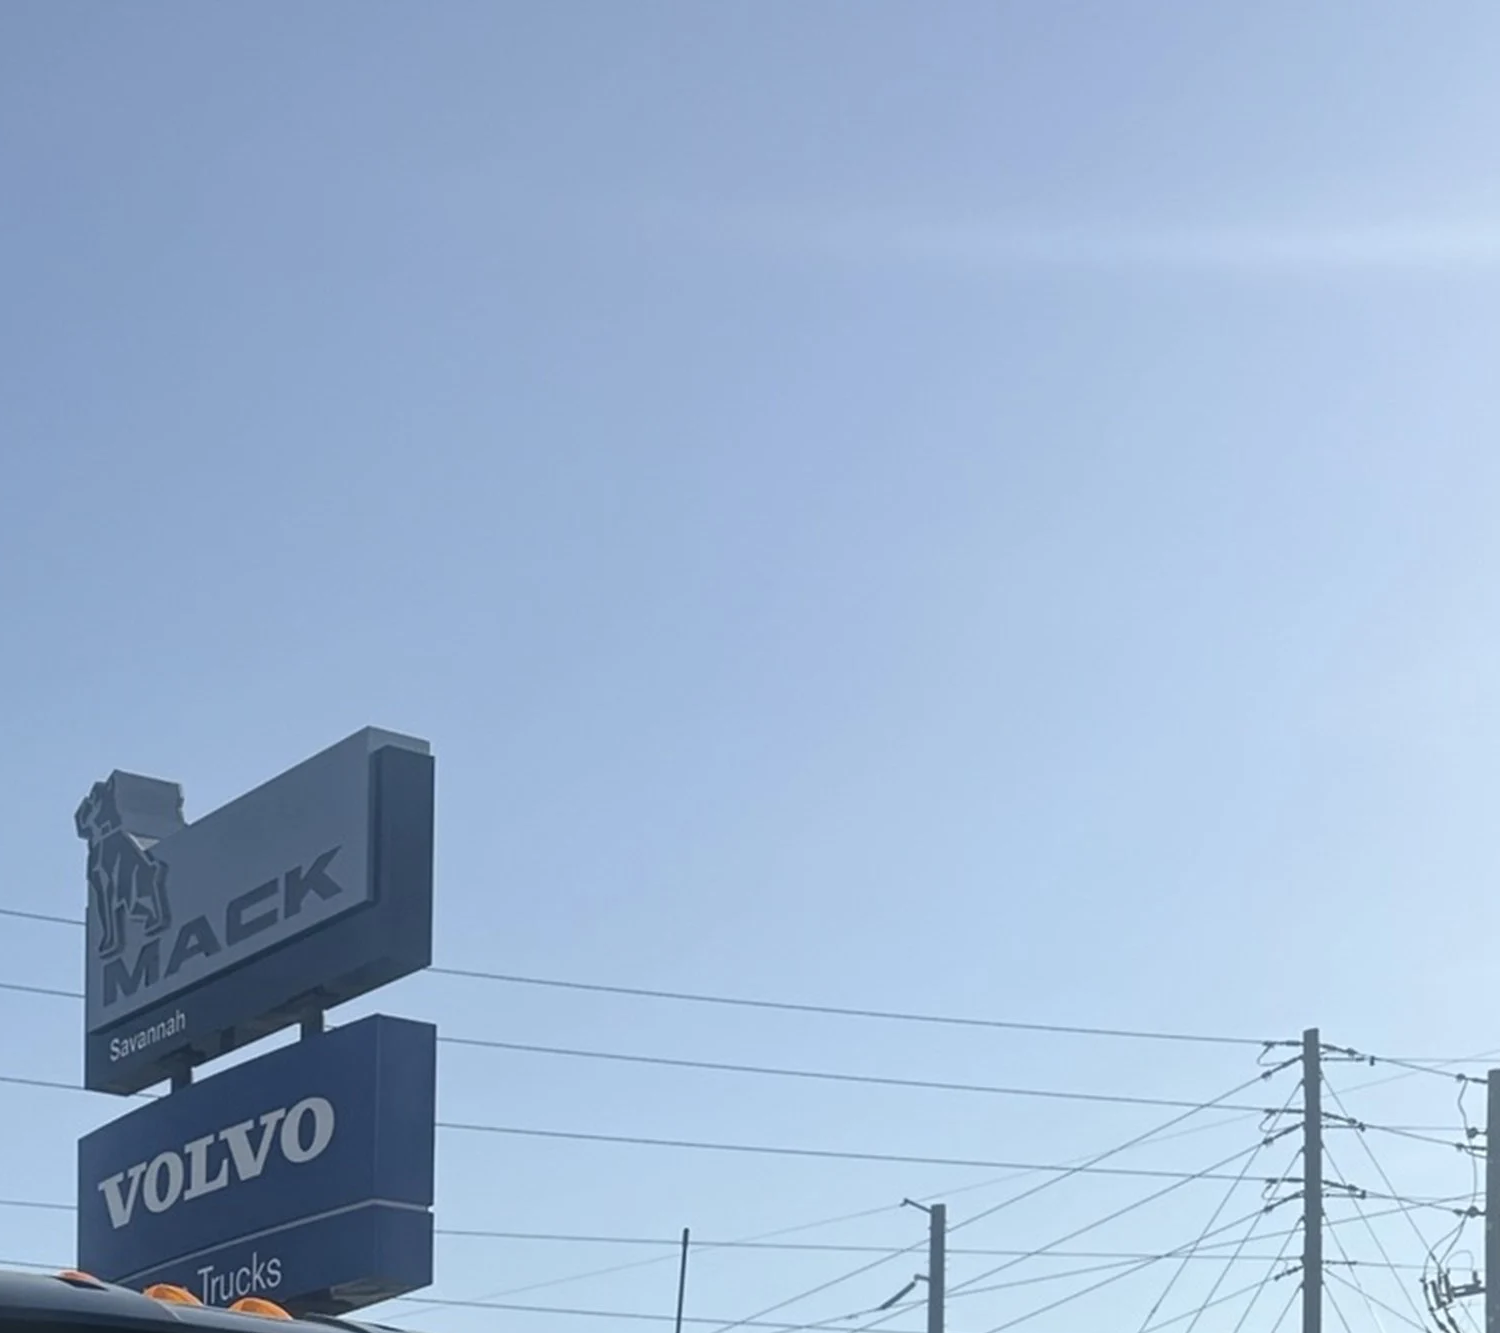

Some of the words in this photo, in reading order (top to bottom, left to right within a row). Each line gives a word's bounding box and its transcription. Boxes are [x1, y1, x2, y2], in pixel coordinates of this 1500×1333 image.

[103, 846, 343, 1008] MACK
[109, 1010, 186, 1062] Savannah
[98, 1097, 334, 1229] VOLVO
[197, 1252, 282, 1305] Trucks
